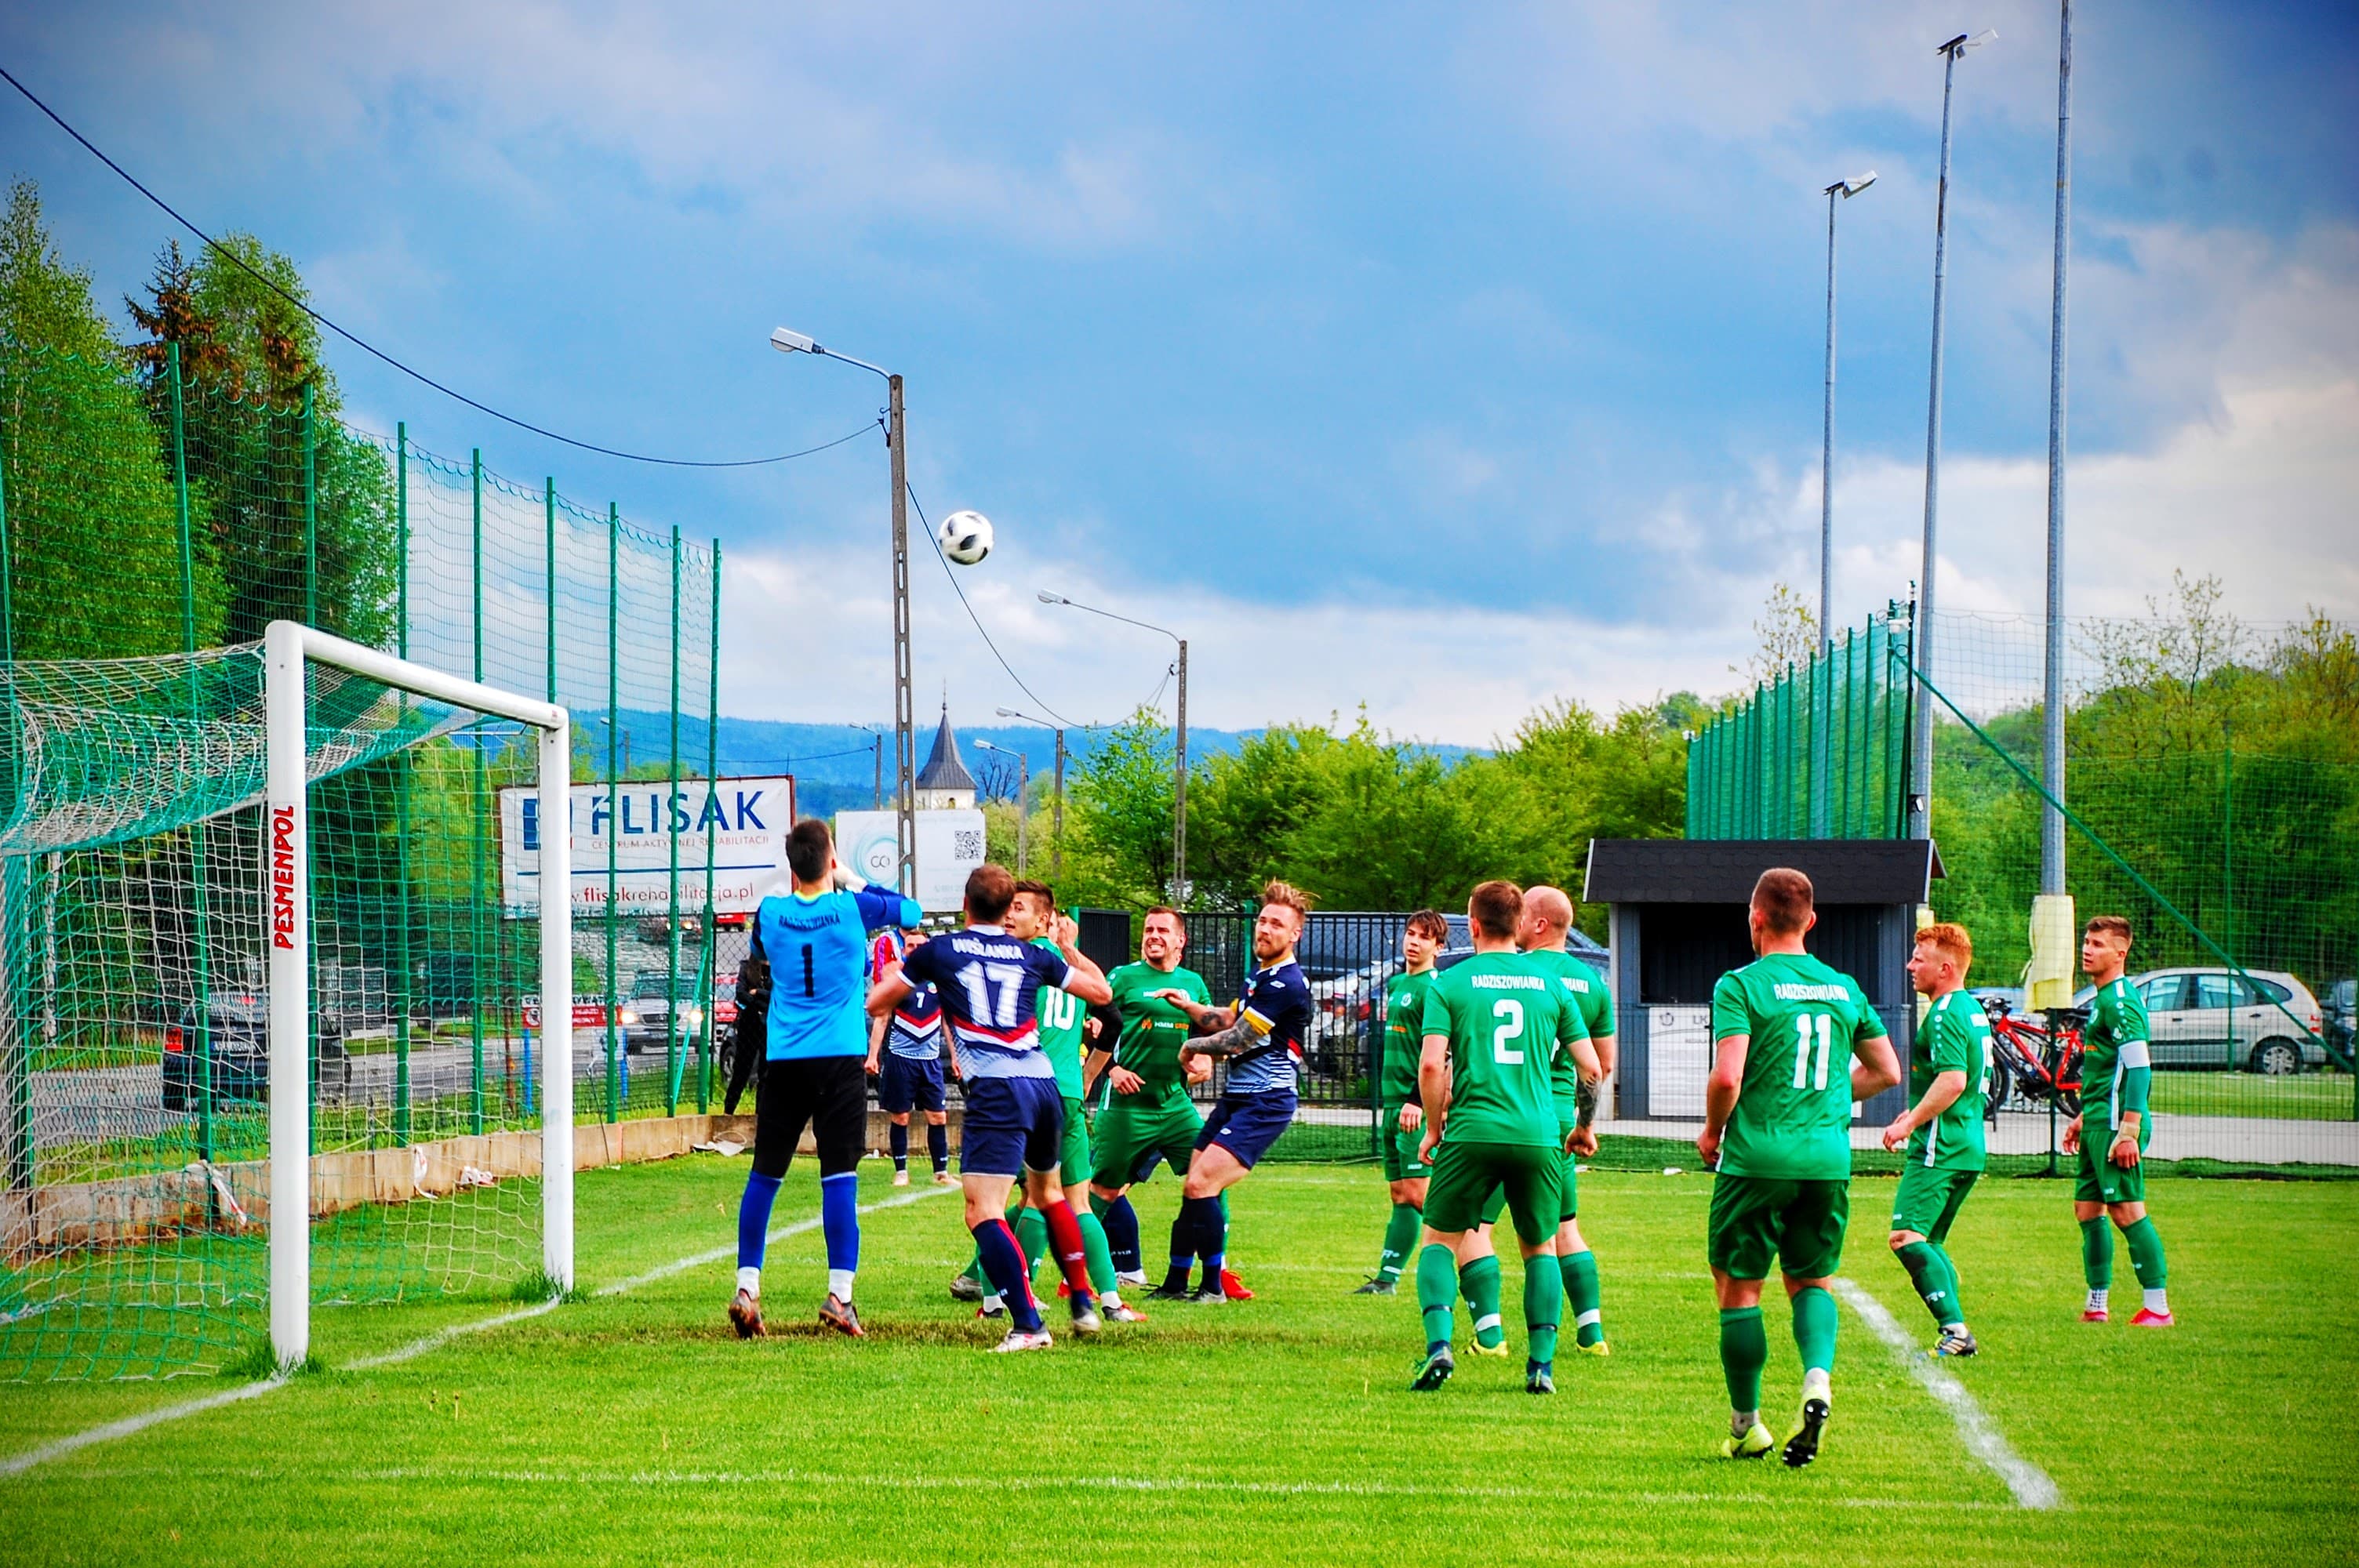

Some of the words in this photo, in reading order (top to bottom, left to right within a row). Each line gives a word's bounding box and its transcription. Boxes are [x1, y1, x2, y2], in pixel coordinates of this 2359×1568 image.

[591, 790, 766, 835] FLISAK
[592, 840, 639, 849] CENRUM
[642, 839, 695, 848] AKTYNEJ
[700, 835, 769, 846] REABILITACJI
[273, 805, 294, 949] PESMENPOL
[801, 943, 814, 997] 1
[954, 960, 1026, 1028] 17
[1471, 975, 1546, 992] RADZISZOWIANKA
[916, 992, 925, 1009] 7
[1043, 985, 1076, 1031] 10
[1492, 999, 1525, 1065] 2
[1793, 1013, 1832, 1091] 11
